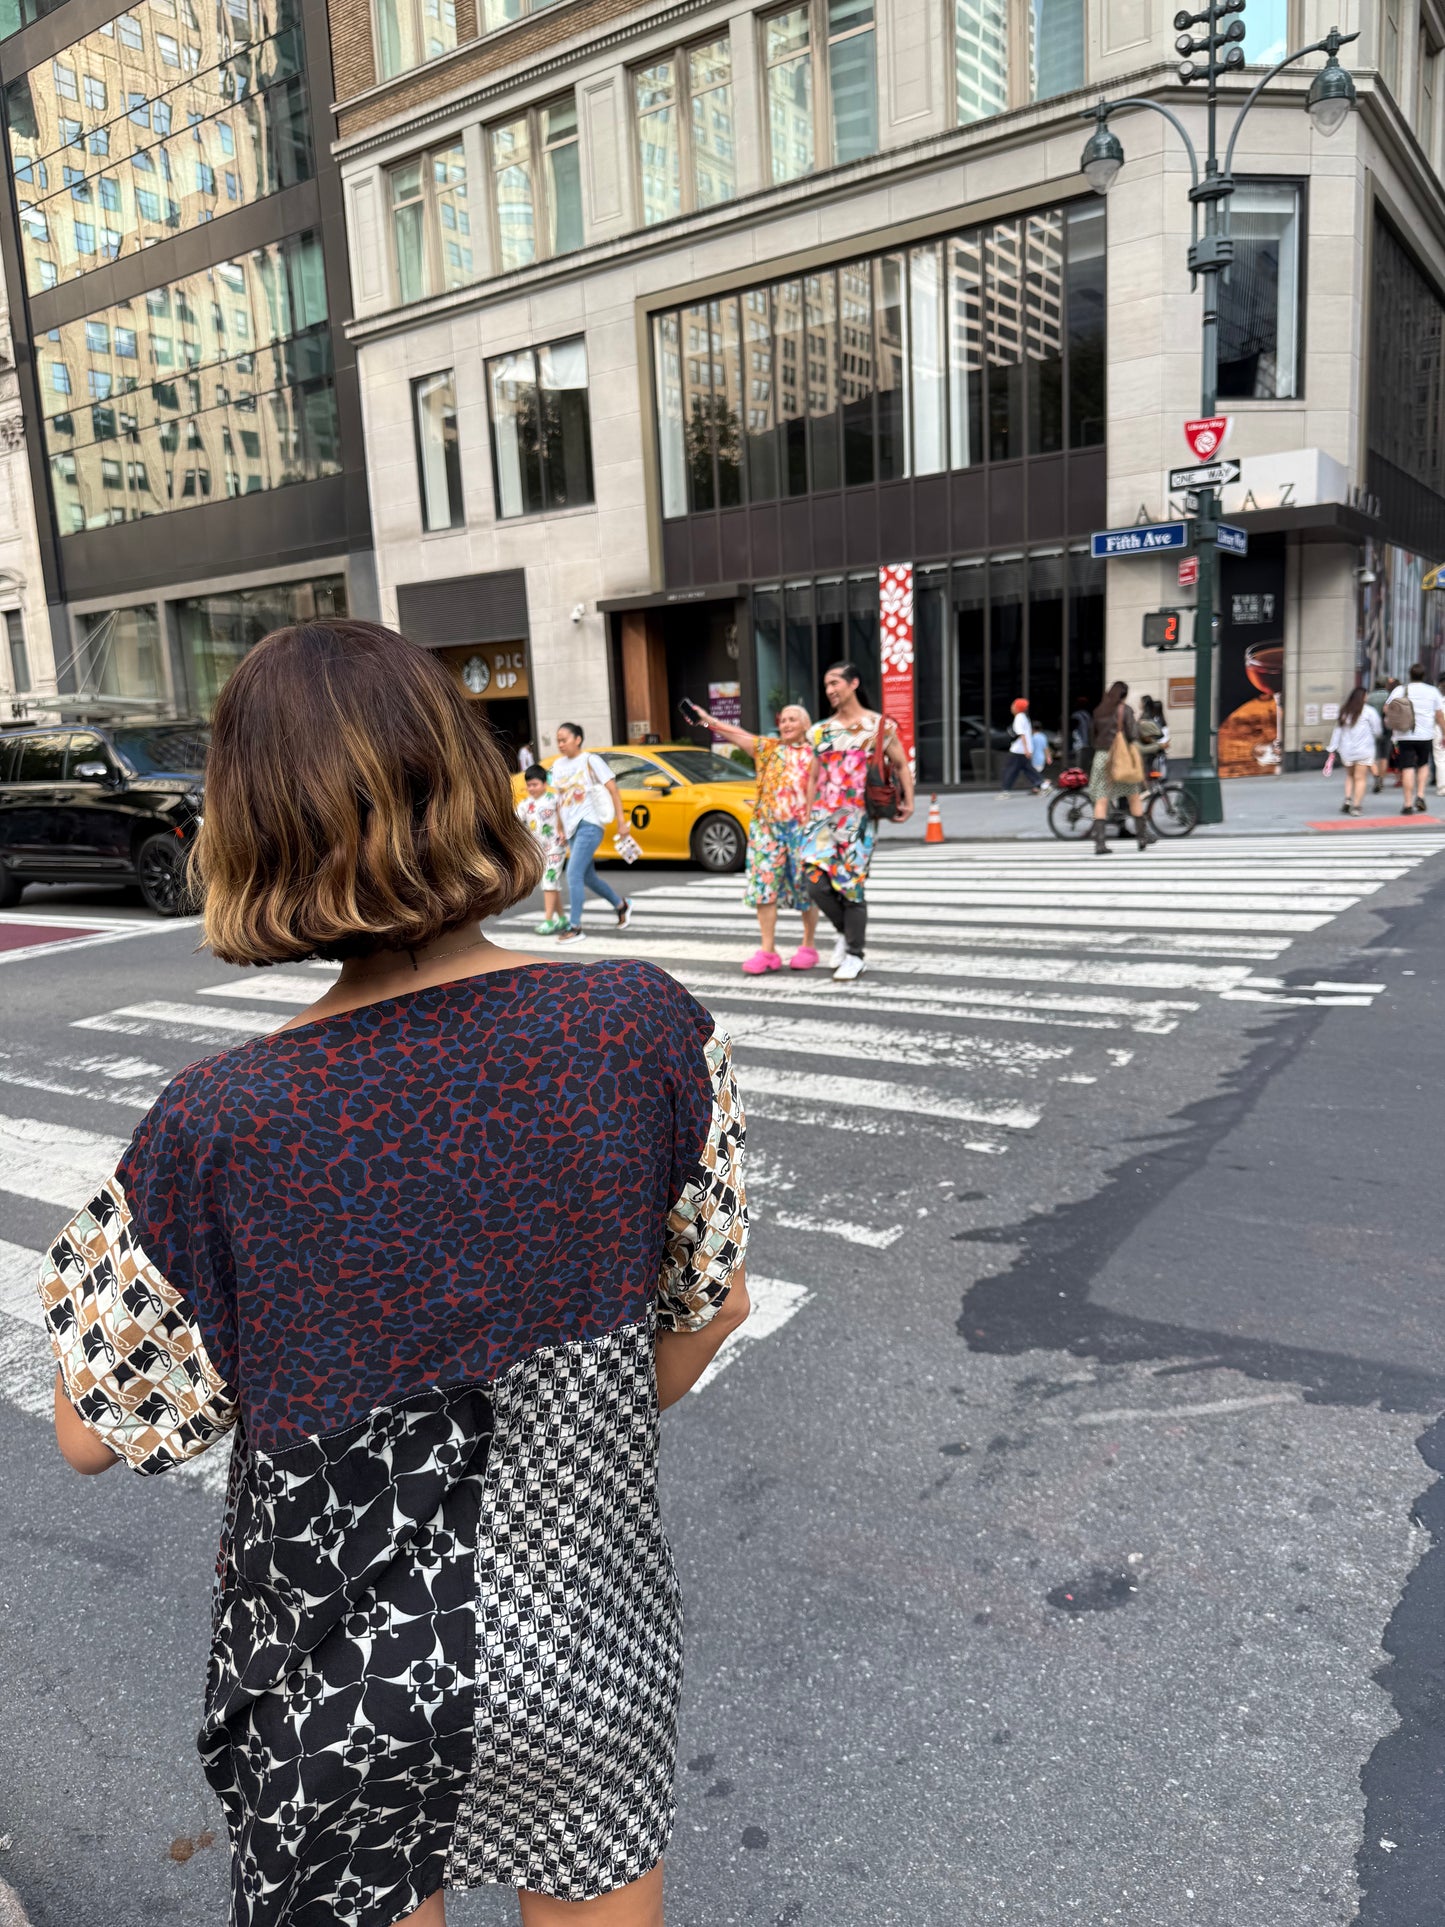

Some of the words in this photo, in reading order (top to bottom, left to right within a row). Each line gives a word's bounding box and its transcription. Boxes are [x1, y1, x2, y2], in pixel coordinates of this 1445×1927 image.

[1174, 473, 1195, 485] ONE
[1207, 467, 1232, 479] WAY
[1135, 483, 1297, 524] ANAZ
[1106, 533, 1141, 552] Fifth
[1143, 531, 1172, 547] Ave
[1165, 617, 1177, 640] 2
[496, 672, 517, 688] UP
[634, 808, 647, 828] T
